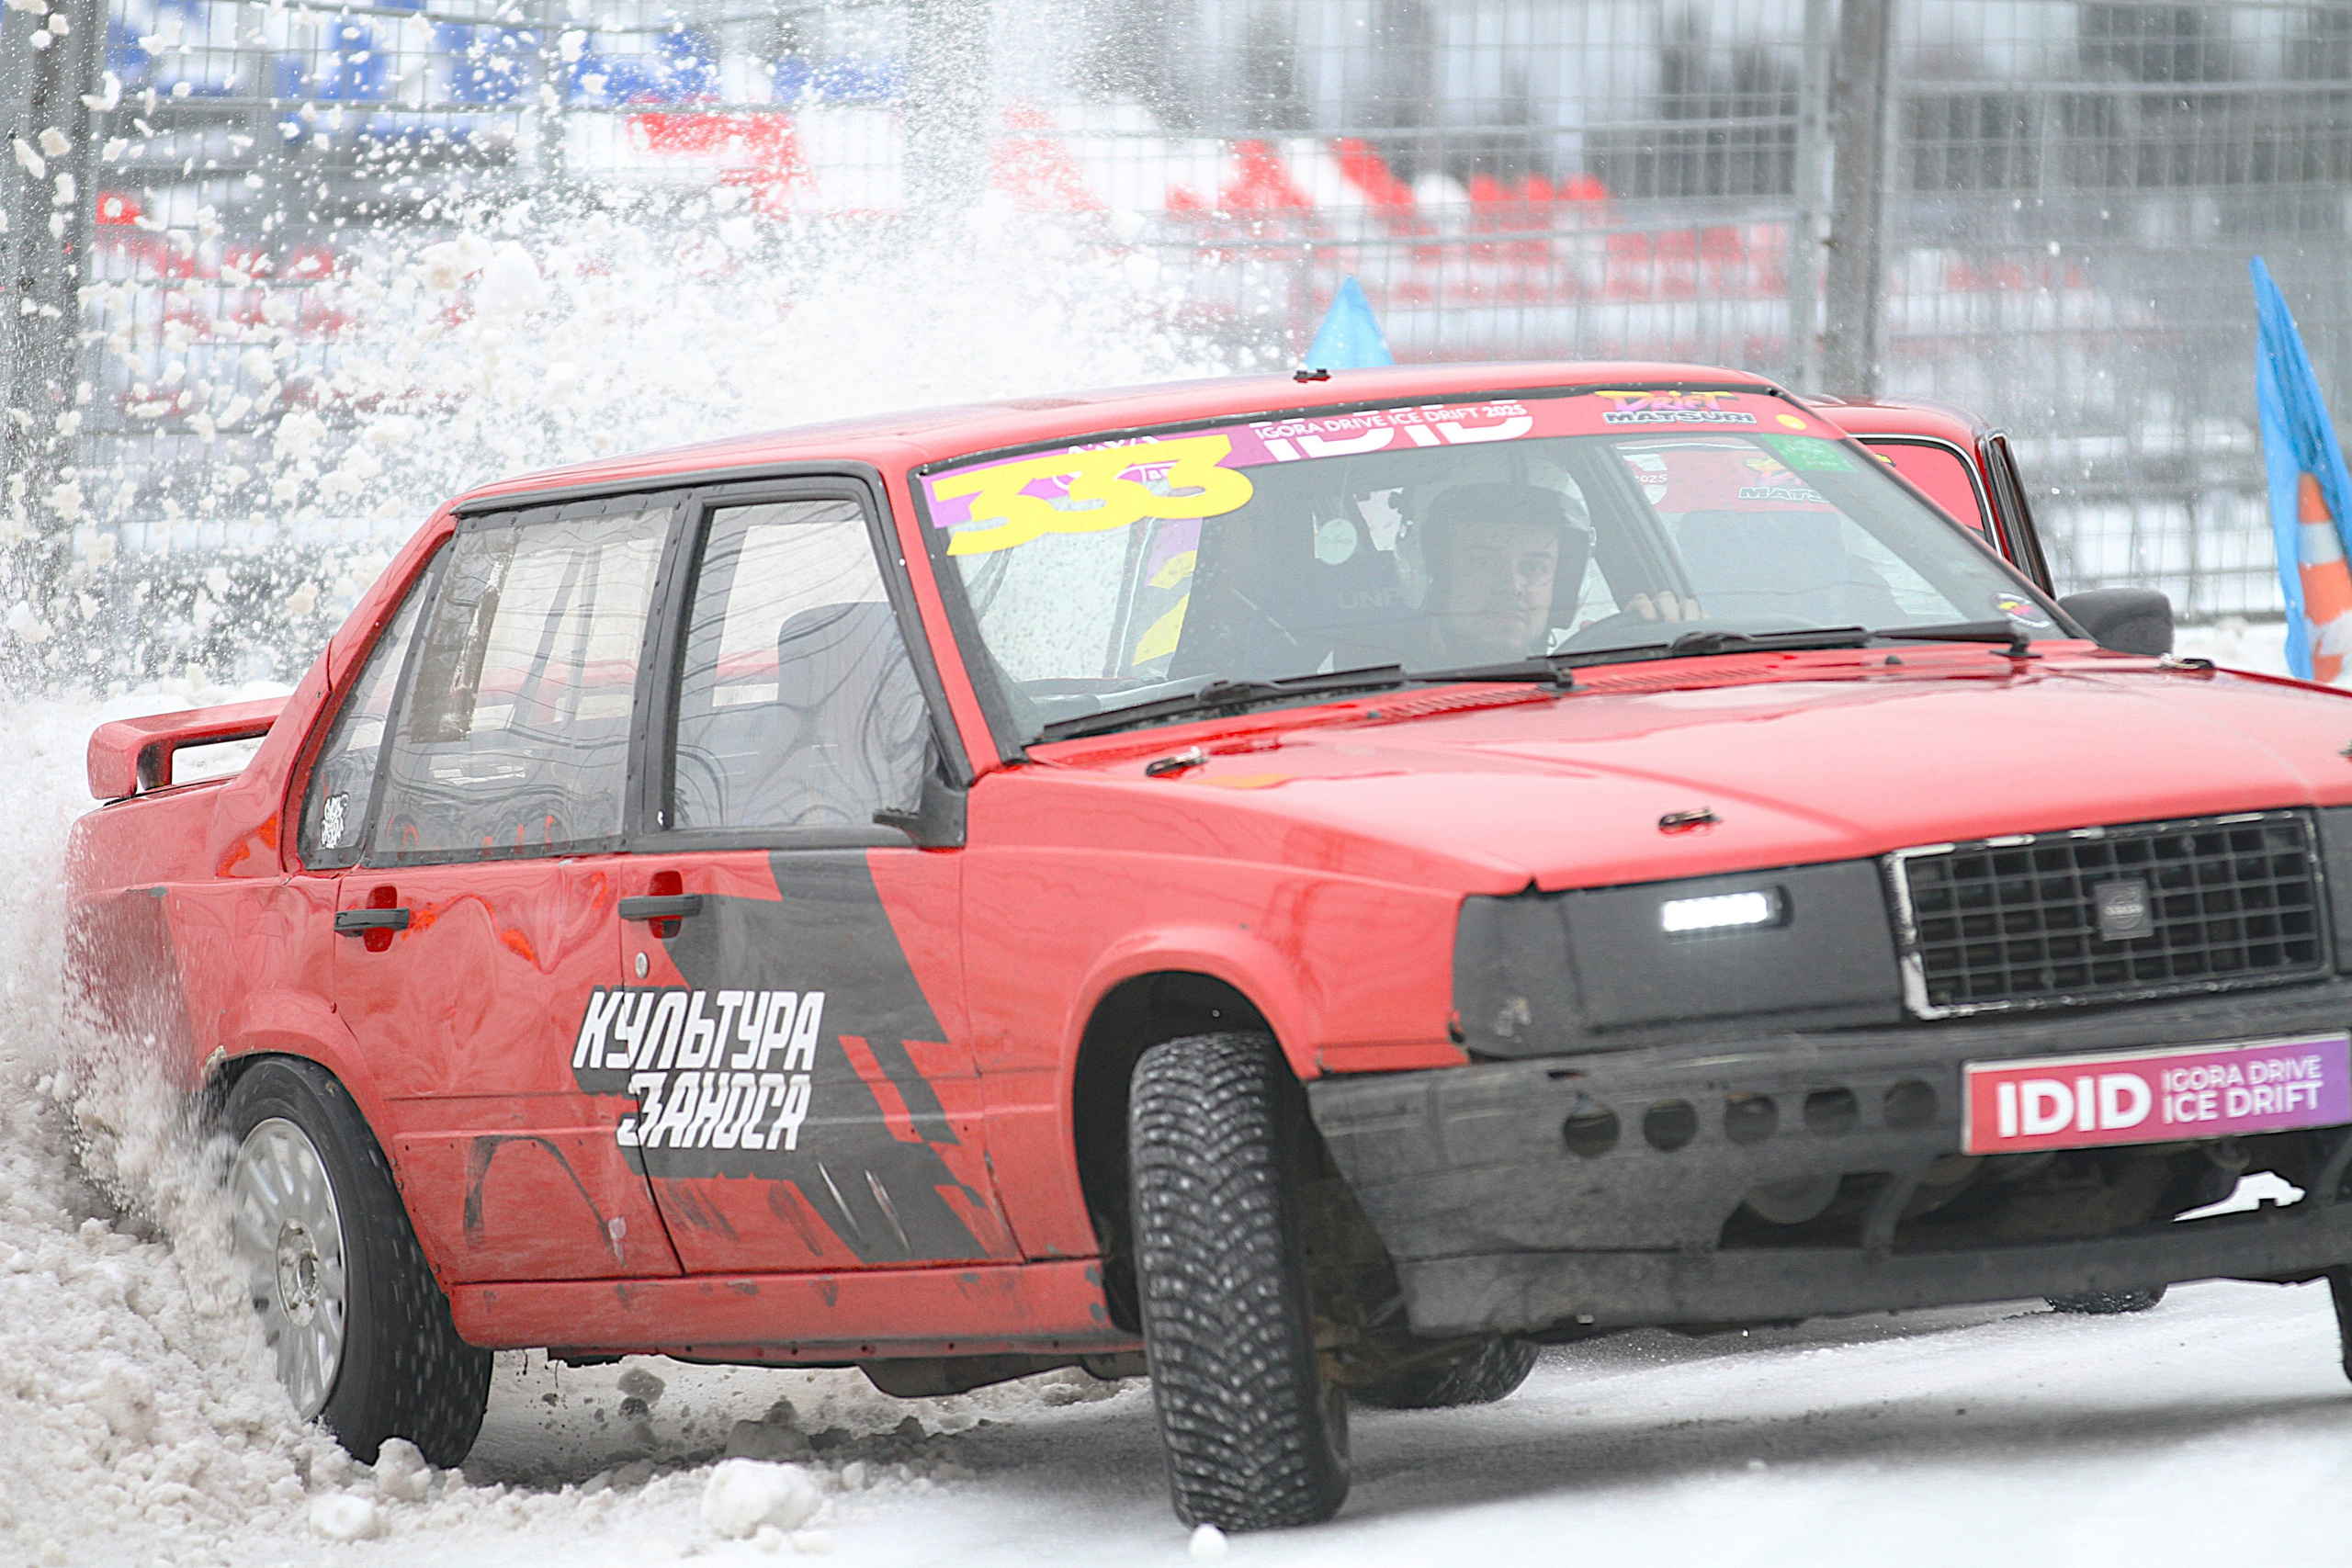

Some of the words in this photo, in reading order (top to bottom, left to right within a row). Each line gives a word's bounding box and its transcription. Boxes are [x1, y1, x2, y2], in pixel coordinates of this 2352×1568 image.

[1255, 422, 1325, 440] IGORA
[1323, 415, 1387, 433] DRIVE
[1387, 412, 1423, 425] ICE
[1423, 407, 1479, 423] DRIFT
[1481, 403, 1528, 418] 2025
[1603, 411, 1757, 424] MATSURI
[931, 434, 1254, 556] 333
[1635, 474, 1668, 484] 025
[572, 990, 826, 1071] КУЛЬТУРА
[2161, 1063, 2245, 1094] IGORA
[2247, 1055, 2323, 1085] DRIVE
[616, 1071, 812, 1151] ЗАНОСА
[1997, 1072, 2152, 1138] IDID
[2163, 1089, 2220, 1124] ICE
[2224, 1079, 2324, 1119] DRIFT
